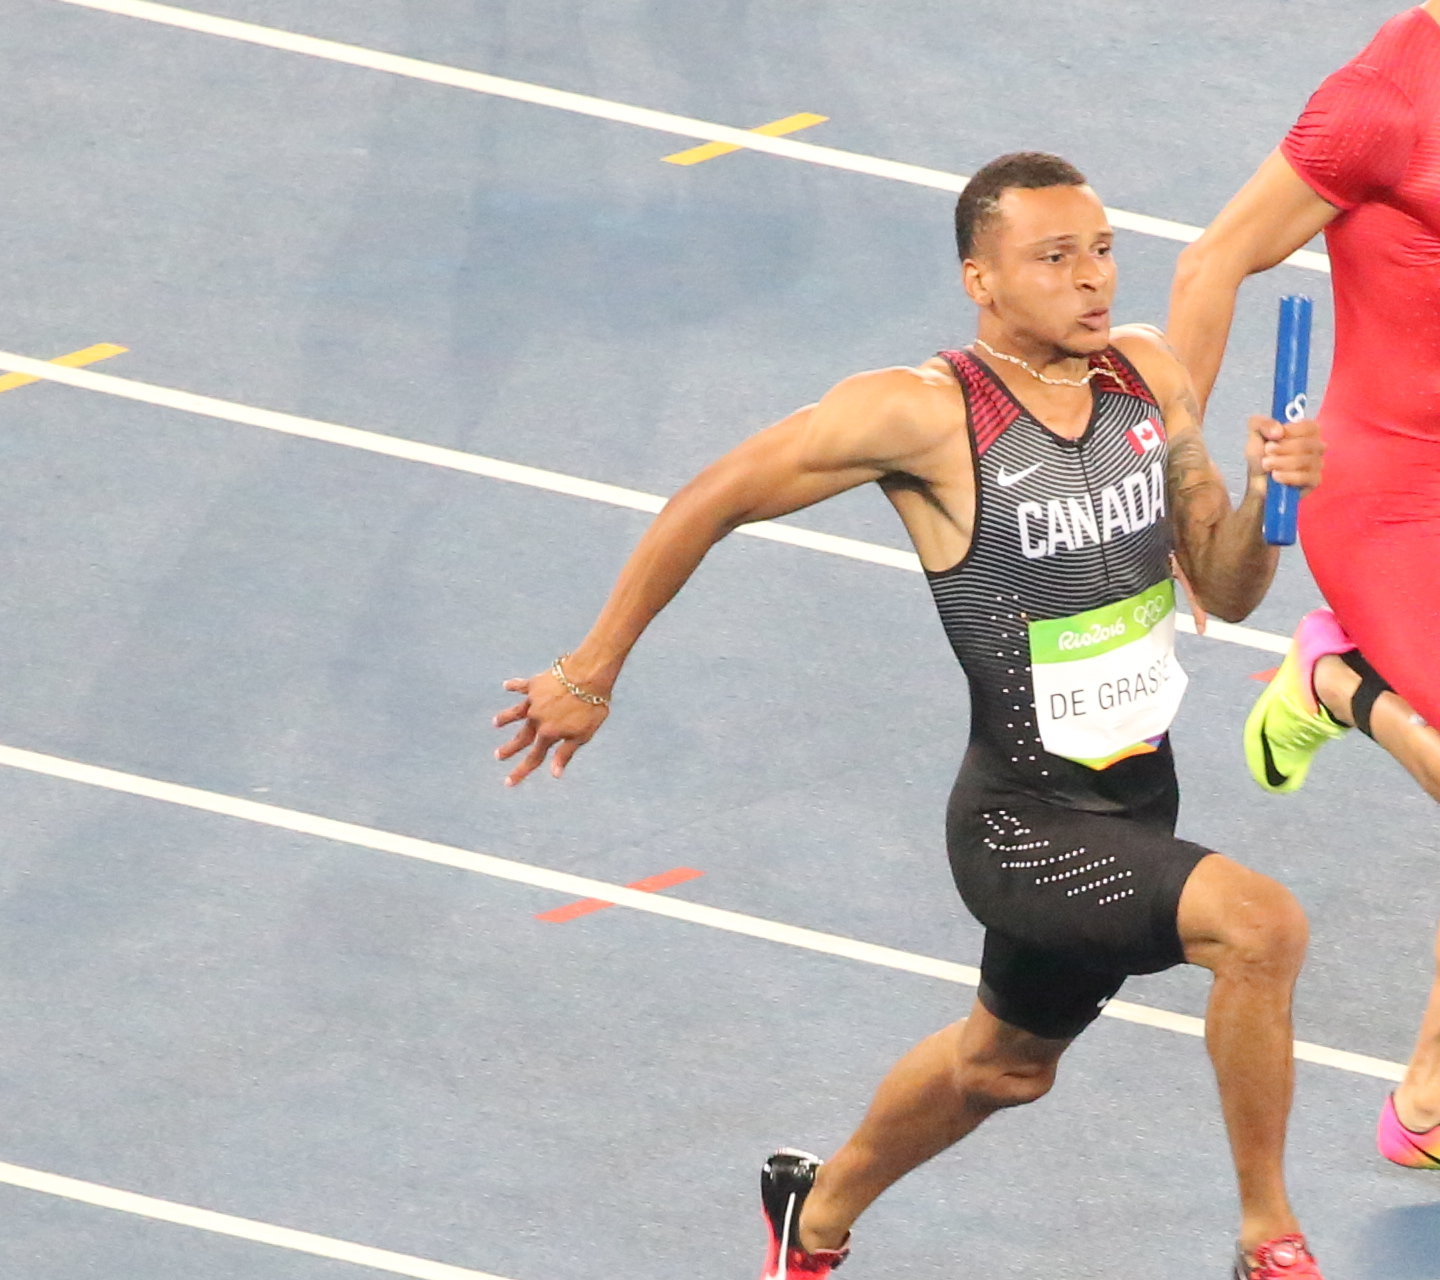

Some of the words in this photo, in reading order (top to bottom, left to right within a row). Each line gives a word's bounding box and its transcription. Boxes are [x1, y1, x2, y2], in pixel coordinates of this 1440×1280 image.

[1017, 461, 1166, 559] CANADA
[1058, 617, 1126, 651] Rio2016
[1050, 689, 1086, 720] DE
